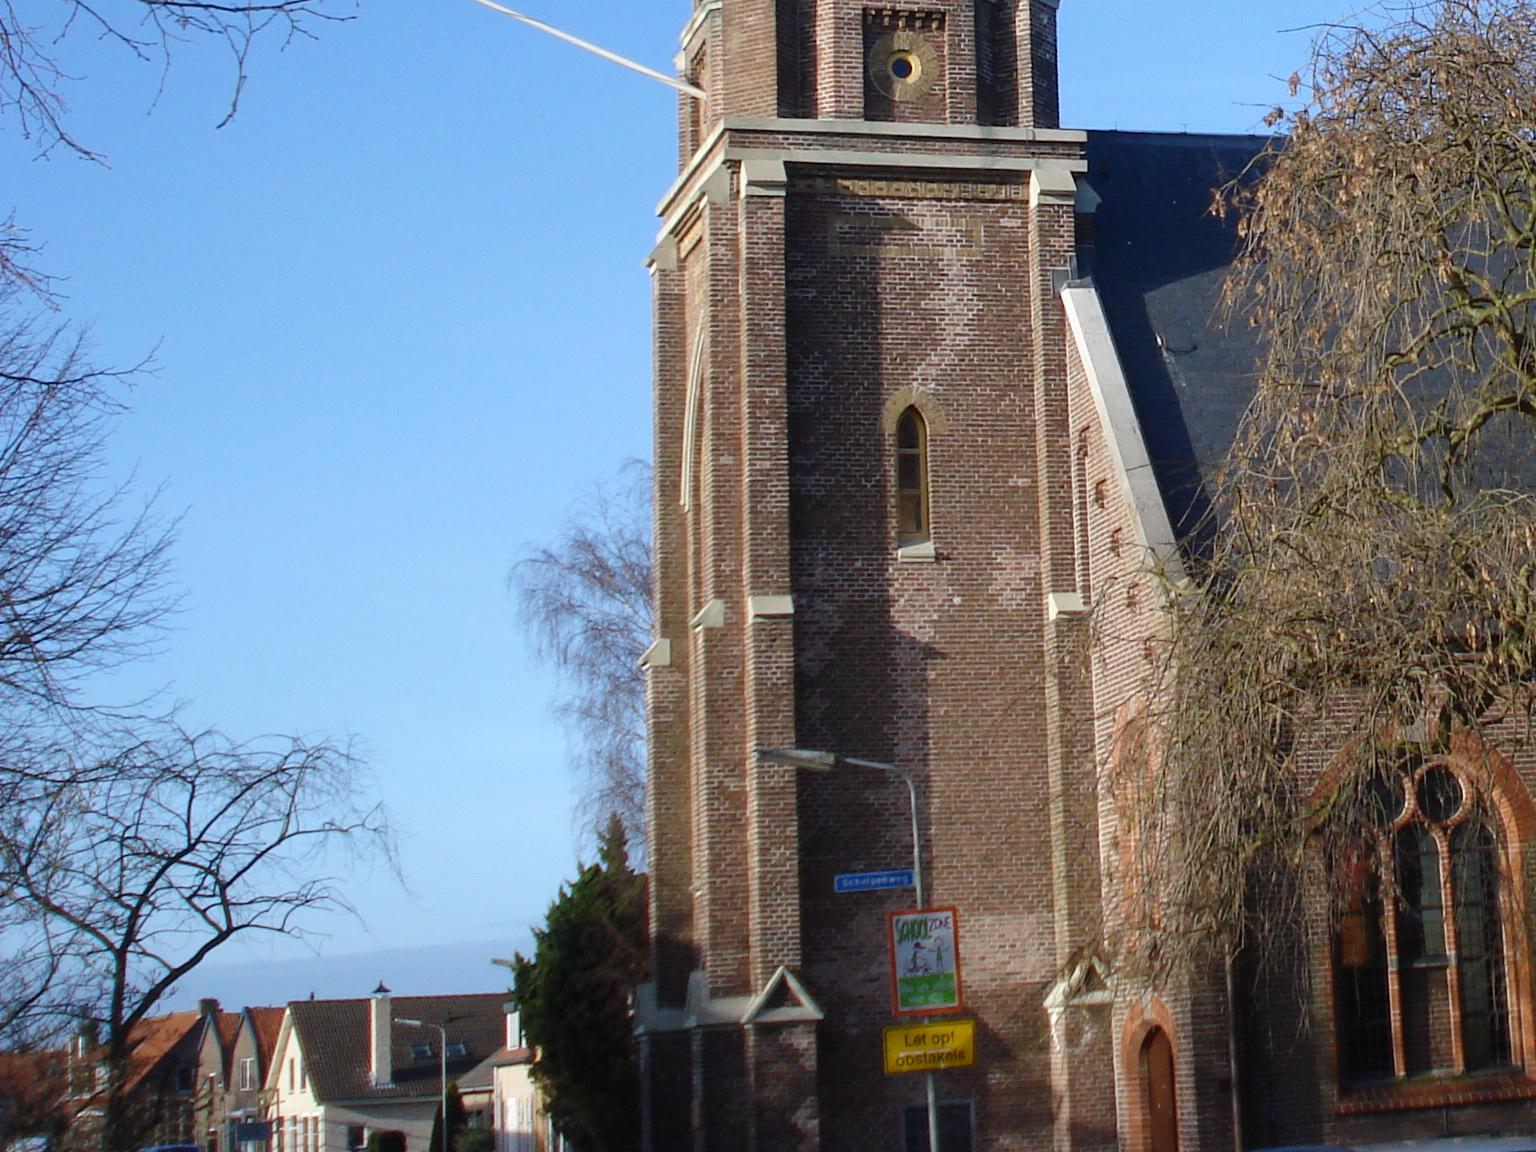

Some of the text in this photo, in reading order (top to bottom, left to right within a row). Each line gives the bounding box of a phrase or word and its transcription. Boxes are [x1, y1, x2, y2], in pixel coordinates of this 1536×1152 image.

[904, 1030, 955, 1047] Let op!
[895, 1048, 966, 1066] obstakels
